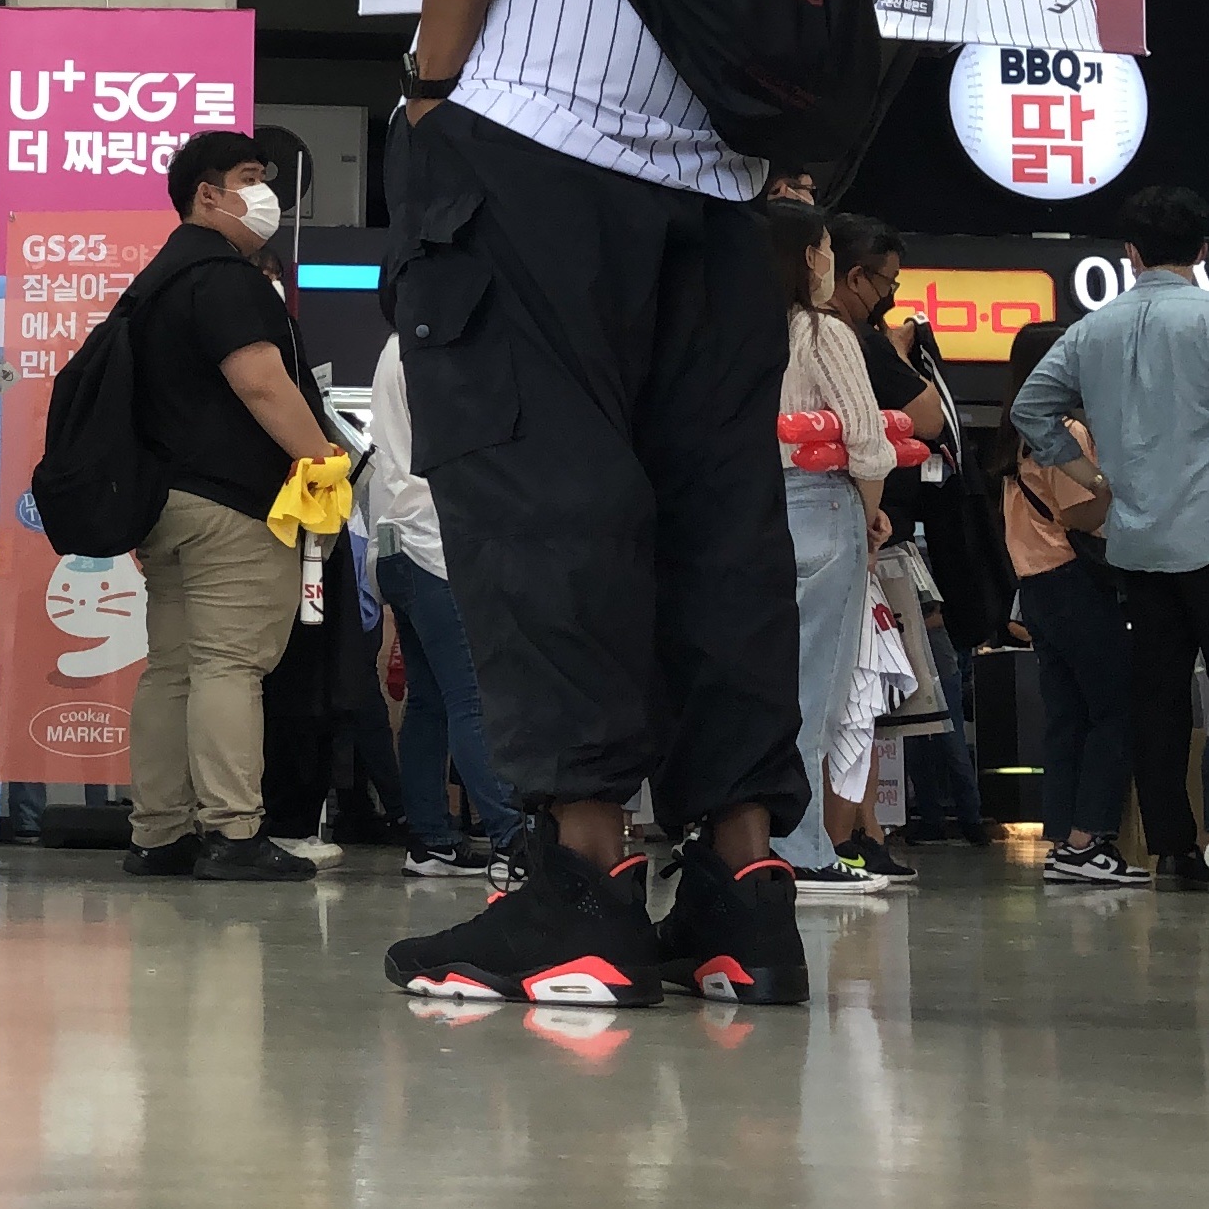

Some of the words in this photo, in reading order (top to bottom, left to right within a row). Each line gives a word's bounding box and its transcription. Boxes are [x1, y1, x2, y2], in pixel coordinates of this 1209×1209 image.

[9, 59, 86, 121] U+
[8, 129, 48, 174] 더
[62, 129, 190, 176] 짜릿하
[22, 234, 107, 263] GS25
[22, 273, 135, 302] 잠실야구
[21, 311, 77, 340] 에서
[59, 708, 111, 724] cookat
[46, 725, 127, 744] MARKET
